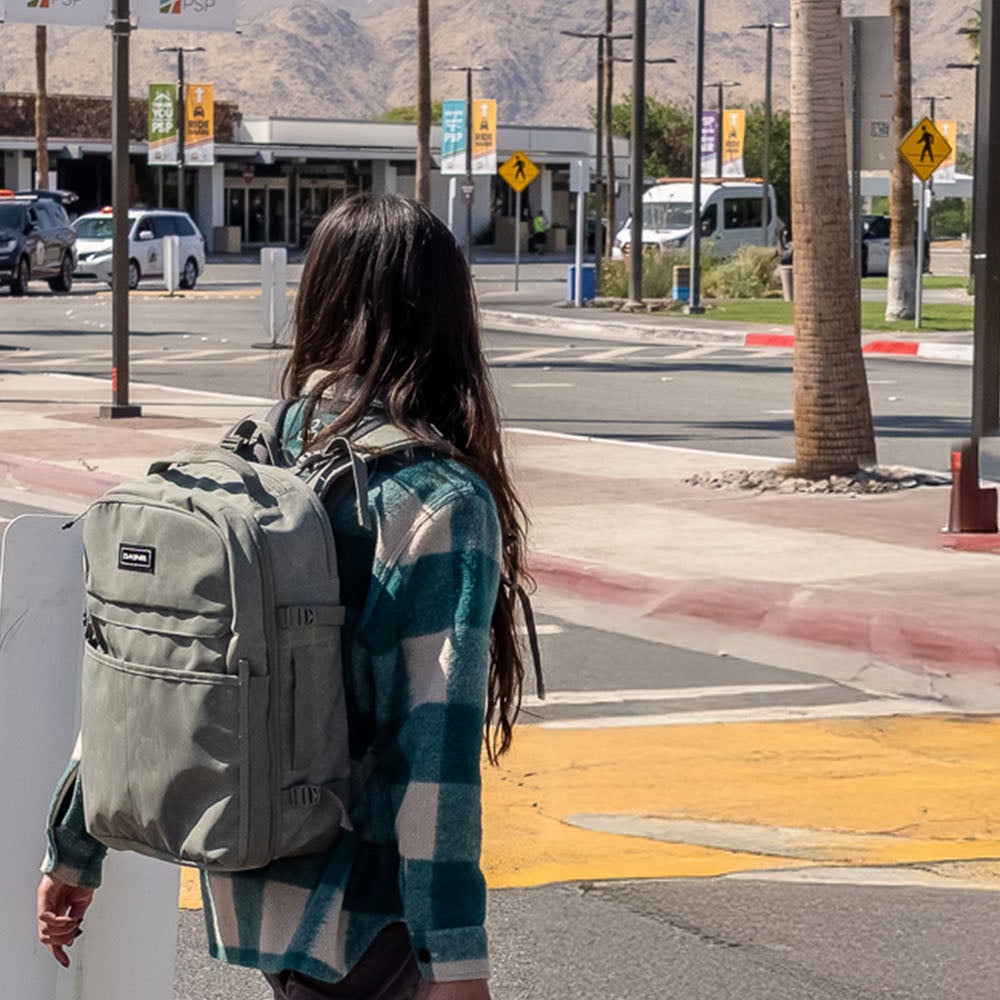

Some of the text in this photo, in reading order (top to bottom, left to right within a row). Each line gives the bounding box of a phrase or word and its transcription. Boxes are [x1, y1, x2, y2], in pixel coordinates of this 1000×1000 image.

[152, 107, 174, 119] YOU
[151, 121, 174, 133] PSP
[188, 120, 210, 129] RIDE
[443, 132, 463, 143] PSP
